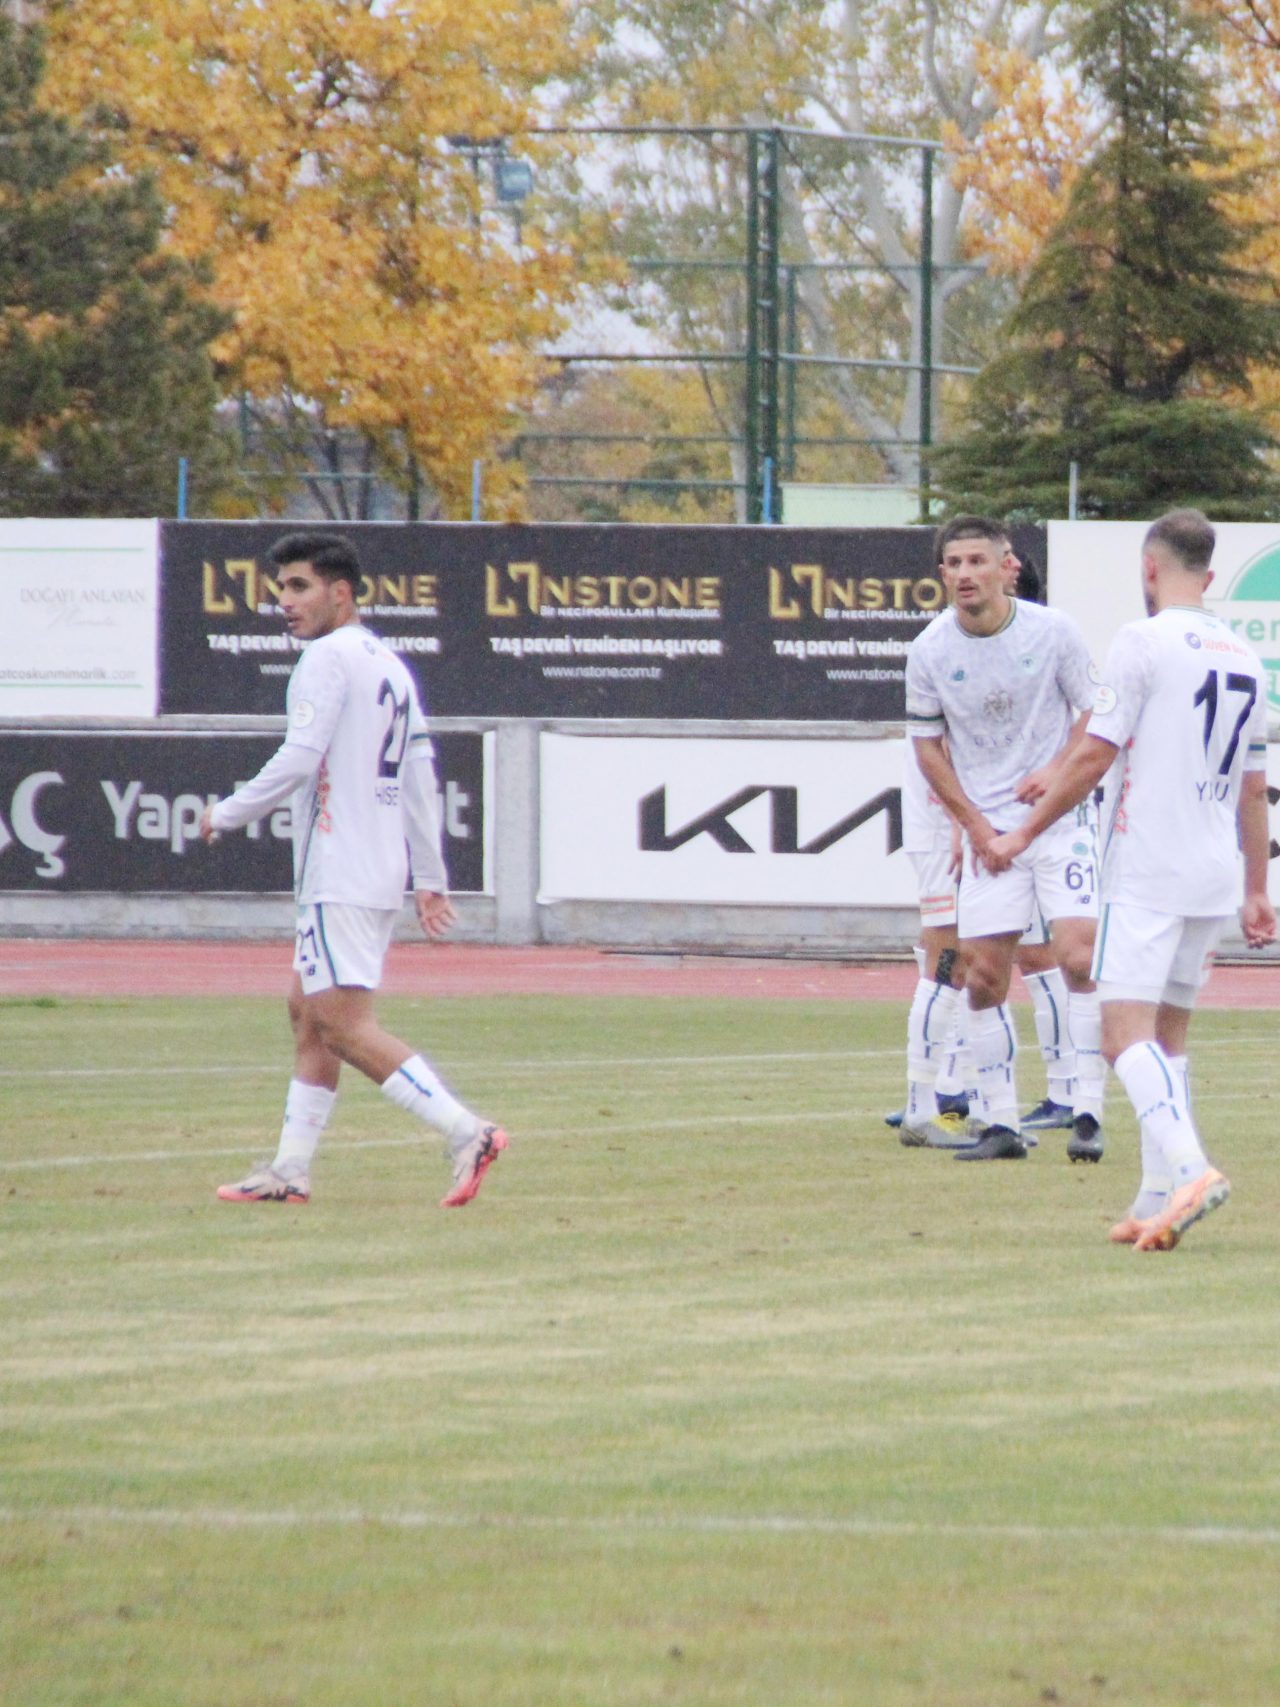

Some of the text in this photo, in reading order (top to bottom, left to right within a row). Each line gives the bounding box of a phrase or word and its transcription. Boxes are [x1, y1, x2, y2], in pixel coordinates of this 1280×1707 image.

[540, 606, 556, 617] Bir
[824, 607, 840, 619] Bir
[207, 634, 240, 655] TAŞ
[242, 632, 289, 651] DEVRİ
[490, 635, 722, 659] TAŞ DEVRİ YENİDEN BAŞLIYOR
[773, 637, 912, 660] TAŞ DEVRİ YENİDE
[376, 676, 411, 778] 21
[1194, 669, 1257, 776] 17
[637, 783, 904, 856] KIA
[1065, 861, 1094, 892] 61
